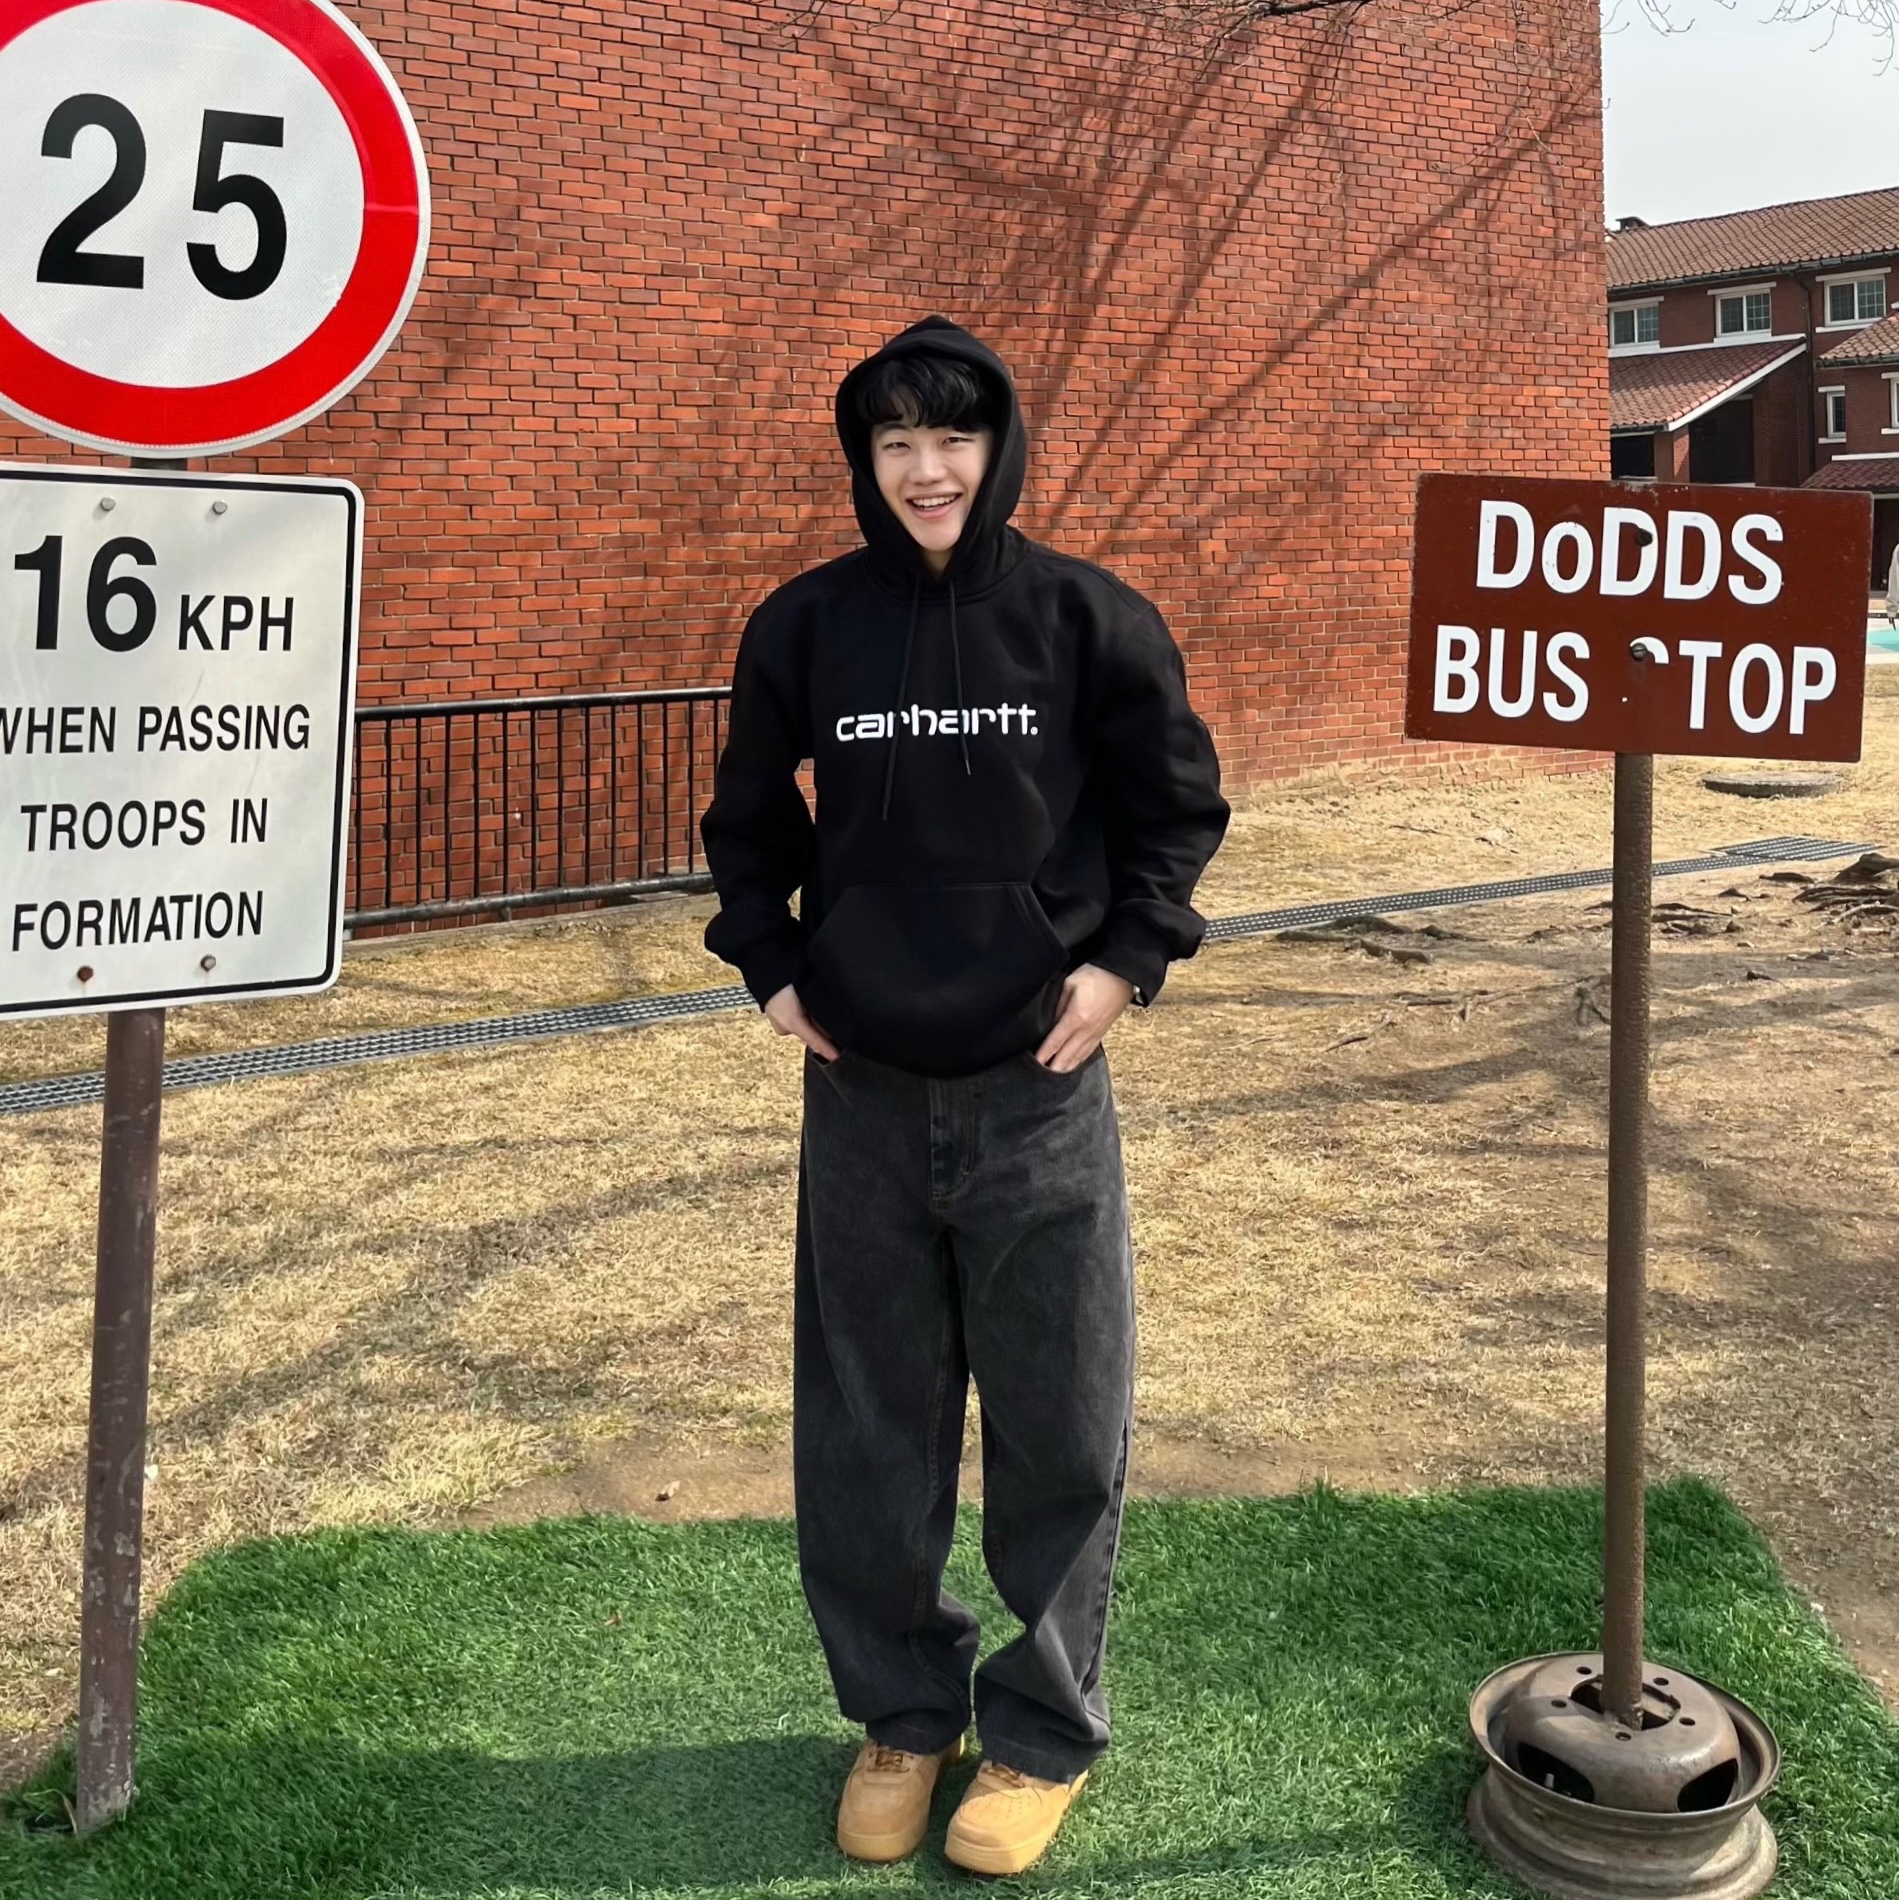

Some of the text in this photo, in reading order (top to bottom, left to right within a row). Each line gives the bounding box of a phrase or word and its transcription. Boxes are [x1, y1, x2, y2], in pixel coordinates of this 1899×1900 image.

[36, 93, 287, 301] 25
[14, 535, 294, 653] 16 KPH
[1476, 499, 1784, 605] DoDDS
[137, 703, 310, 752] PASSING
[1433, 624, 1837, 735] BUS TOP
[20, 797, 268, 852] TROOPS IN
[12, 890, 263, 952] FORMATION
